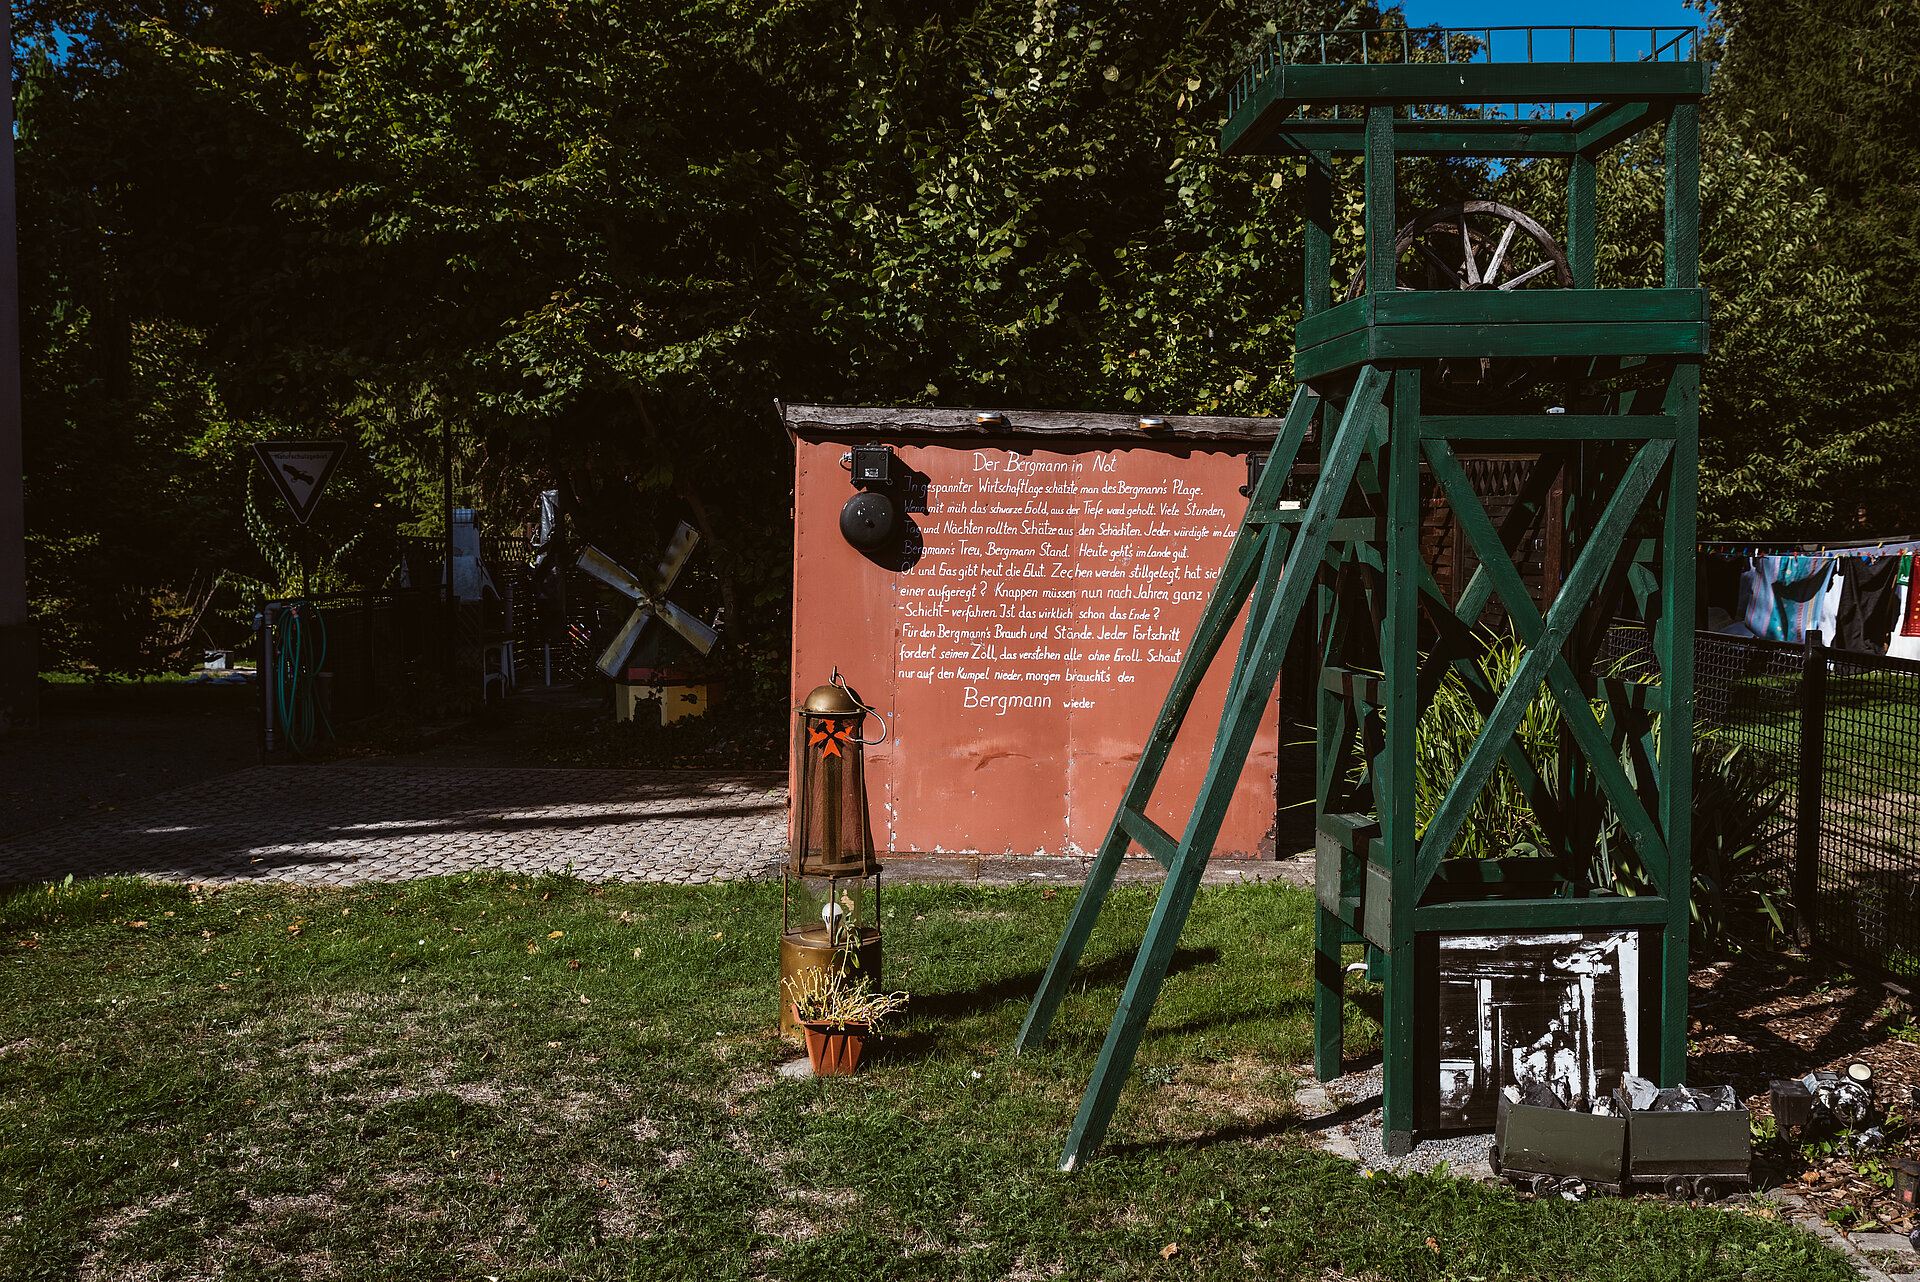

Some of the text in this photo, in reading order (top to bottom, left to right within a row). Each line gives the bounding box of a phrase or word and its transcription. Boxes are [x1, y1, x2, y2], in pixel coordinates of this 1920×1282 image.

[972, 452, 1117, 477] Der Bergmann in Not
[903, 475, 918, 492] In
[920, 477, 974, 499] gespannter
[978, 477, 1044, 499] Wirtschaftlage
[1044, 480, 1079, 495] schätzte
[1080, 486, 1099, 495] man
[1101, 480, 1116, 494] des
[1172, 479, 1204, 502] Plage.
[903, 499, 926, 513] Wenn
[927, 501, 945, 514] mit
[969, 500, 987, 514] das
[989, 501, 1023, 514] schwarze
[1024, 500, 1049, 517] Gold,
[1050, 507, 1065, 515] aus
[1066, 503, 1081, 515] der
[1082, 500, 1104, 519] Tiefe
[1106, 502, 1126, 515] ward
[1126, 503, 1157, 519] geholt.
[1160, 502, 1180, 516] Viele
[1183, 503, 1226, 519] Stunden,
[903, 520, 921, 538] Tag
[922, 522, 941, 535] und
[942, 518, 984, 535] Nächten
[985, 520, 1018, 535] rollten
[1019, 519, 1058, 536] Schätze
[1058, 527, 1074, 536] aus
[1077, 523, 1096, 536] den
[1143, 521, 1173, 537] Jeder
[1173, 525, 1210, 541] würdigte
[1212, 525, 1222, 538] im
[1222, 523, 1237, 538] Lan
[957, 539, 983, 558] Treu,
[984, 541, 1036, 561] Bergmann
[1038, 541, 1069, 558] Stand.
[1078, 543, 1109, 558] Heute
[1135, 546, 1147, 558] im
[1147, 545, 1172, 558] Lande
[1172, 545, 1190, 563] gut.
[901, 556, 916, 576] Öl
[917, 564, 937, 576] und
[939, 561, 957, 577] Gas
[958, 563, 979, 581] gibt
[981, 563, 1005, 577] heut
[1006, 562, 1022, 577] die
[1022, 562, 1045, 578] Glut.
[1050, 562, 1094, 579] Zechen
[1095, 564, 1127, 578] werden
[1128, 563, 1181, 584] stillgelegt,
[1183, 564, 1203, 580] hat
[899, 584, 926, 597] einer
[927, 584, 977, 603] aufgeregt
[993, 582, 1039, 602] Knappen
[1042, 588, 1077, 599] müssen
[1080, 588, 1103, 599] nun
[1106, 583, 1133, 599] nach
[1171, 589, 1203, 605] ganz
[999, 603, 1016, 618] Ist
[1018, 604, 1037, 619] das
[1038, 607, 1073, 619] wirklich
[1078, 606, 1106, 620] schon
[1108, 605, 1128, 620] das
[1128, 607, 1151, 621] Ende
[902, 622, 919, 638] Für
[919, 623, 936, 639] den
[993, 623, 1028, 639] Brauch
[1029, 625, 1048, 640] und
[1053, 623, 1095, 640] Stände.
[1096, 623, 1129, 640] Jeder
[1132, 624, 1181, 642] Fortschritt
[898, 642, 1183, 664] fordert seinen Zoll, das verstehen alle ohne Groll. Schaut
[898, 670, 916, 679] nur
[916, 666, 936, 685] auf
[937, 665, 955, 680] den
[956, 666, 991, 684] Kumpel
[993, 668, 1024, 682] nieder,
[1025, 672, 1061, 686] morgen
[1117, 670, 1135, 683] den
[963, 686, 1096, 716] Bergmann wieder
